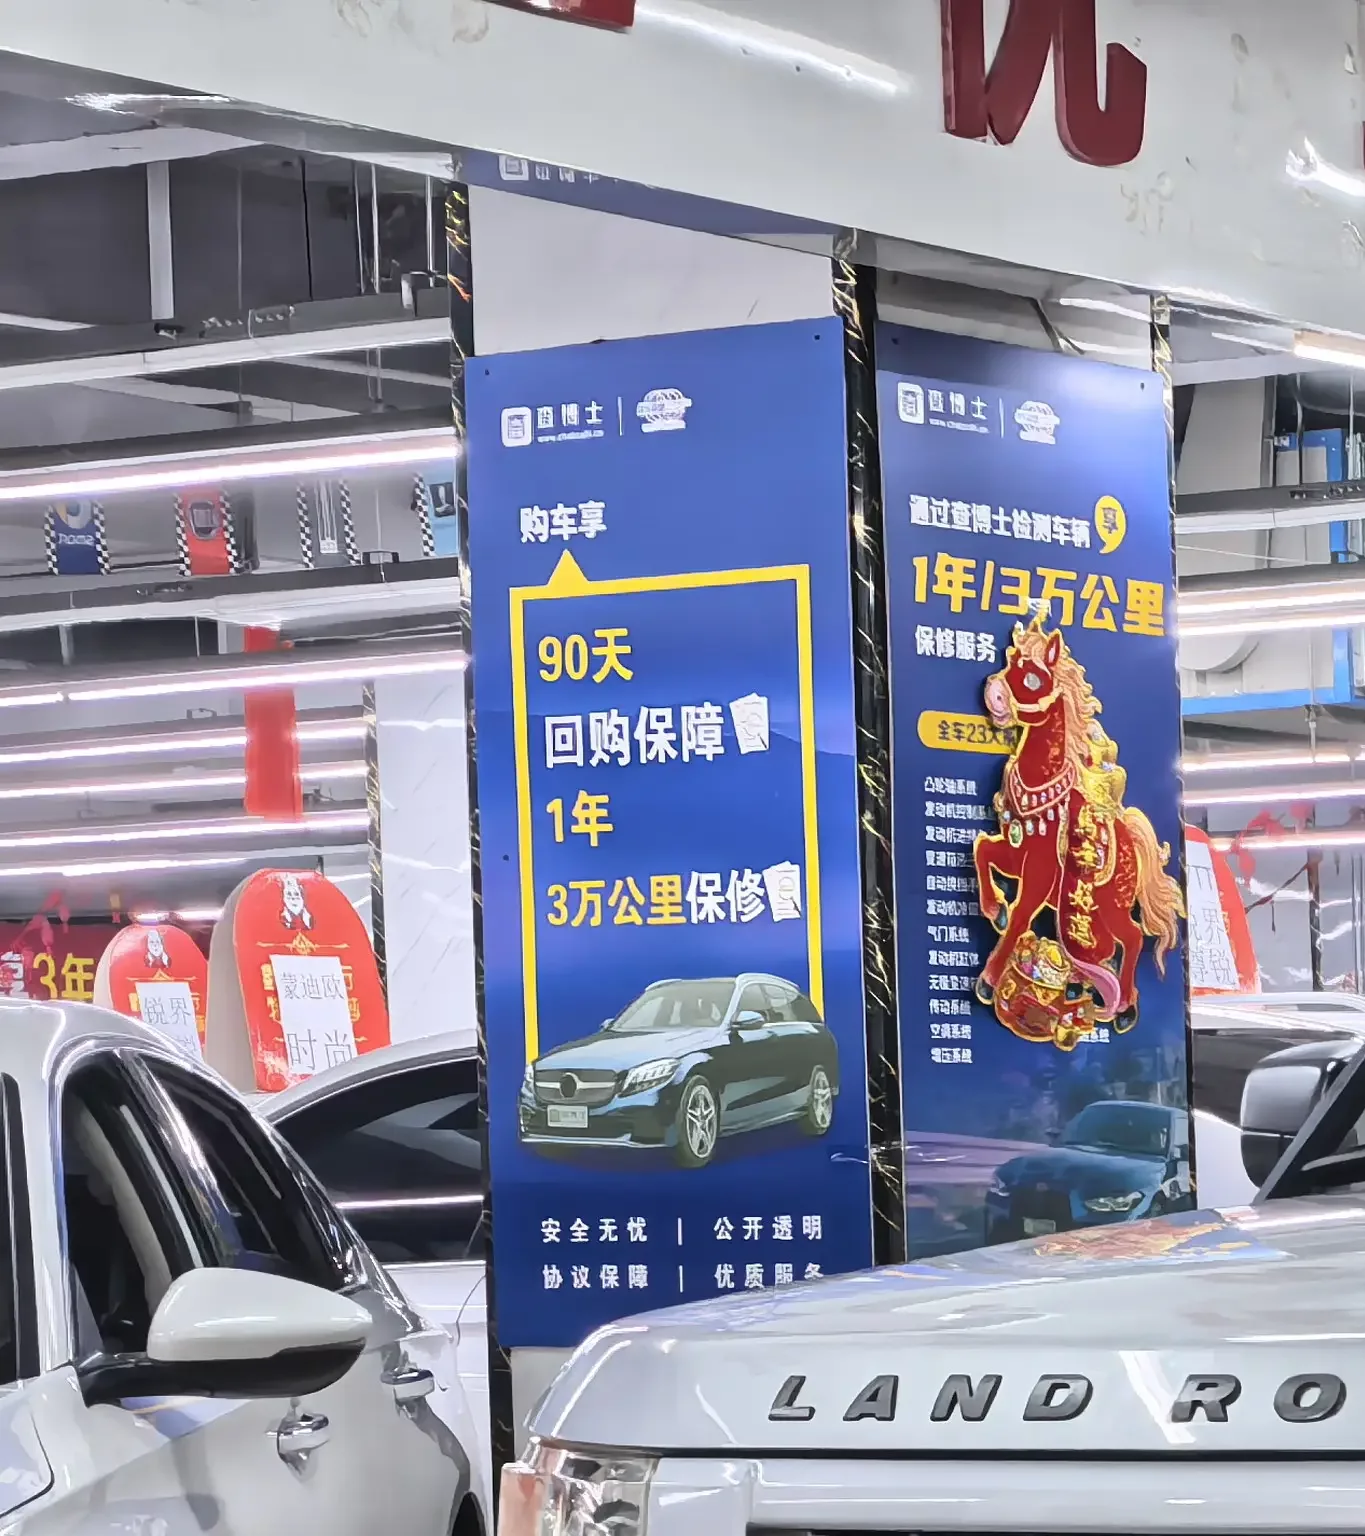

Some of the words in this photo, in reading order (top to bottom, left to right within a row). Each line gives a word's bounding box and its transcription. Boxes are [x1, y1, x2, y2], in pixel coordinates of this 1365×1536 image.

[520, 500, 607, 544] 购车享
[913, 552, 1165, 637] 1年/3万公里
[538, 628, 634, 684] 90天
[915, 624, 996, 662] 保修服务
[544, 701, 725, 769] 回购保障
[546, 790, 614, 847] 1年
[546, 871, 765, 927] 3万公里保修
[32, 952, 95, 999] 3年
[281, 971, 345, 1000] 蒙迪欧
[144, 997, 191, 1025] 锐界
[287, 1029, 352, 1071] 时尚
[540, 1217, 648, 1244] 安全无忧
[714, 1215, 823, 1241] 公开透明
[542, 1264, 649, 1289] 协议保障
[768, 1373, 1094, 1422] LAND
